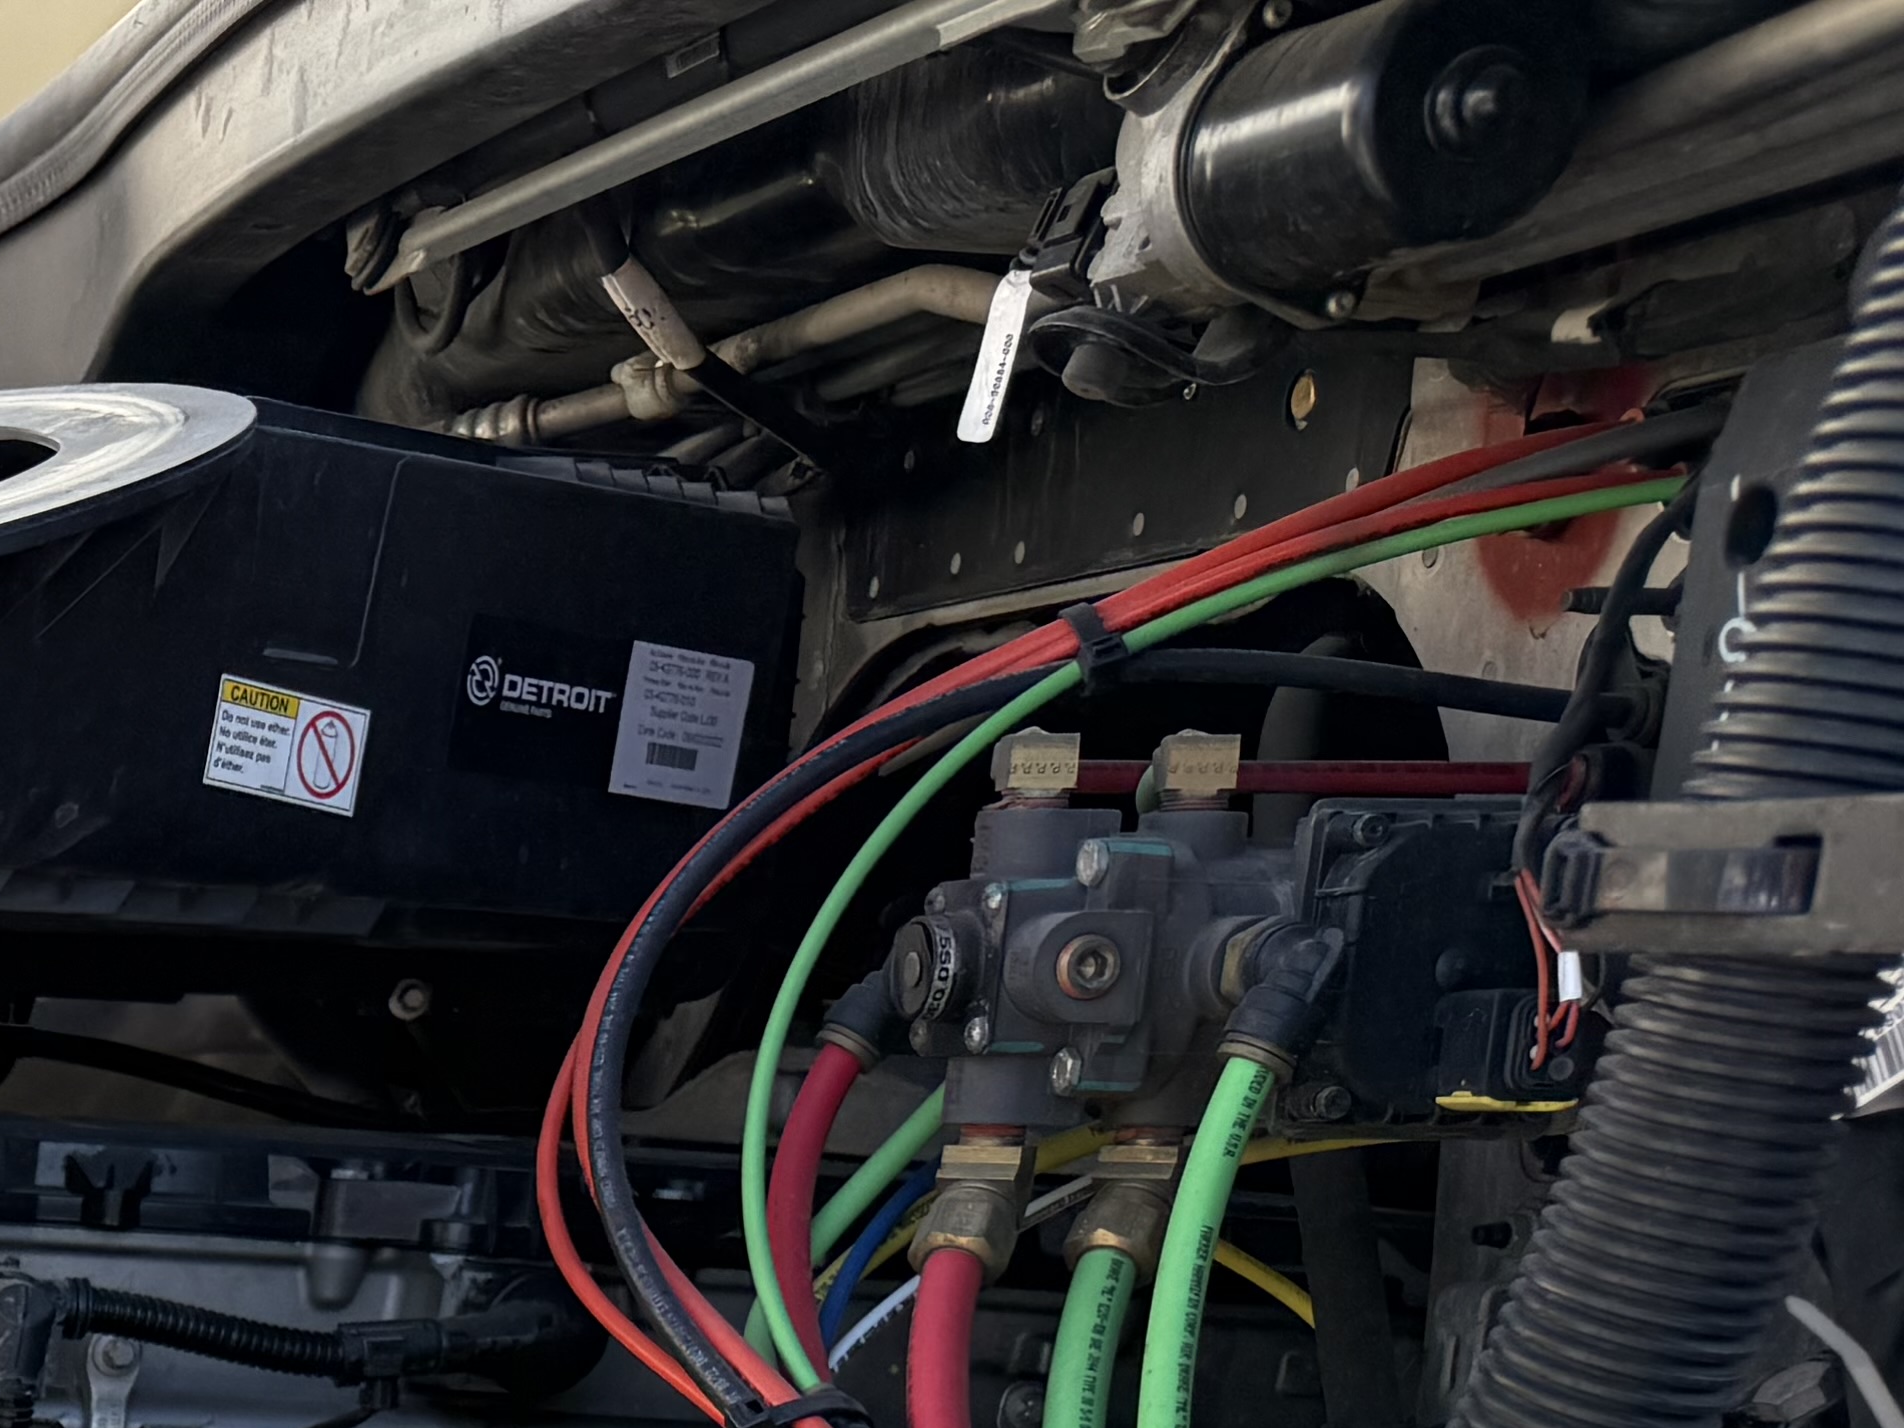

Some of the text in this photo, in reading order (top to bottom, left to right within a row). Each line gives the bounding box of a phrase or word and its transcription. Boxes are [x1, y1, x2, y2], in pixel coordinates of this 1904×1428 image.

[230, 686, 289, 713] CAUTION
[503, 674, 611, 712] DETROIT
[222, 710, 233, 722] Do
[236, 714, 249, 725] not
[251, 720, 265, 730] use
[220, 726, 230, 737] No
[1231, 1110, 1250, 1131] THE
